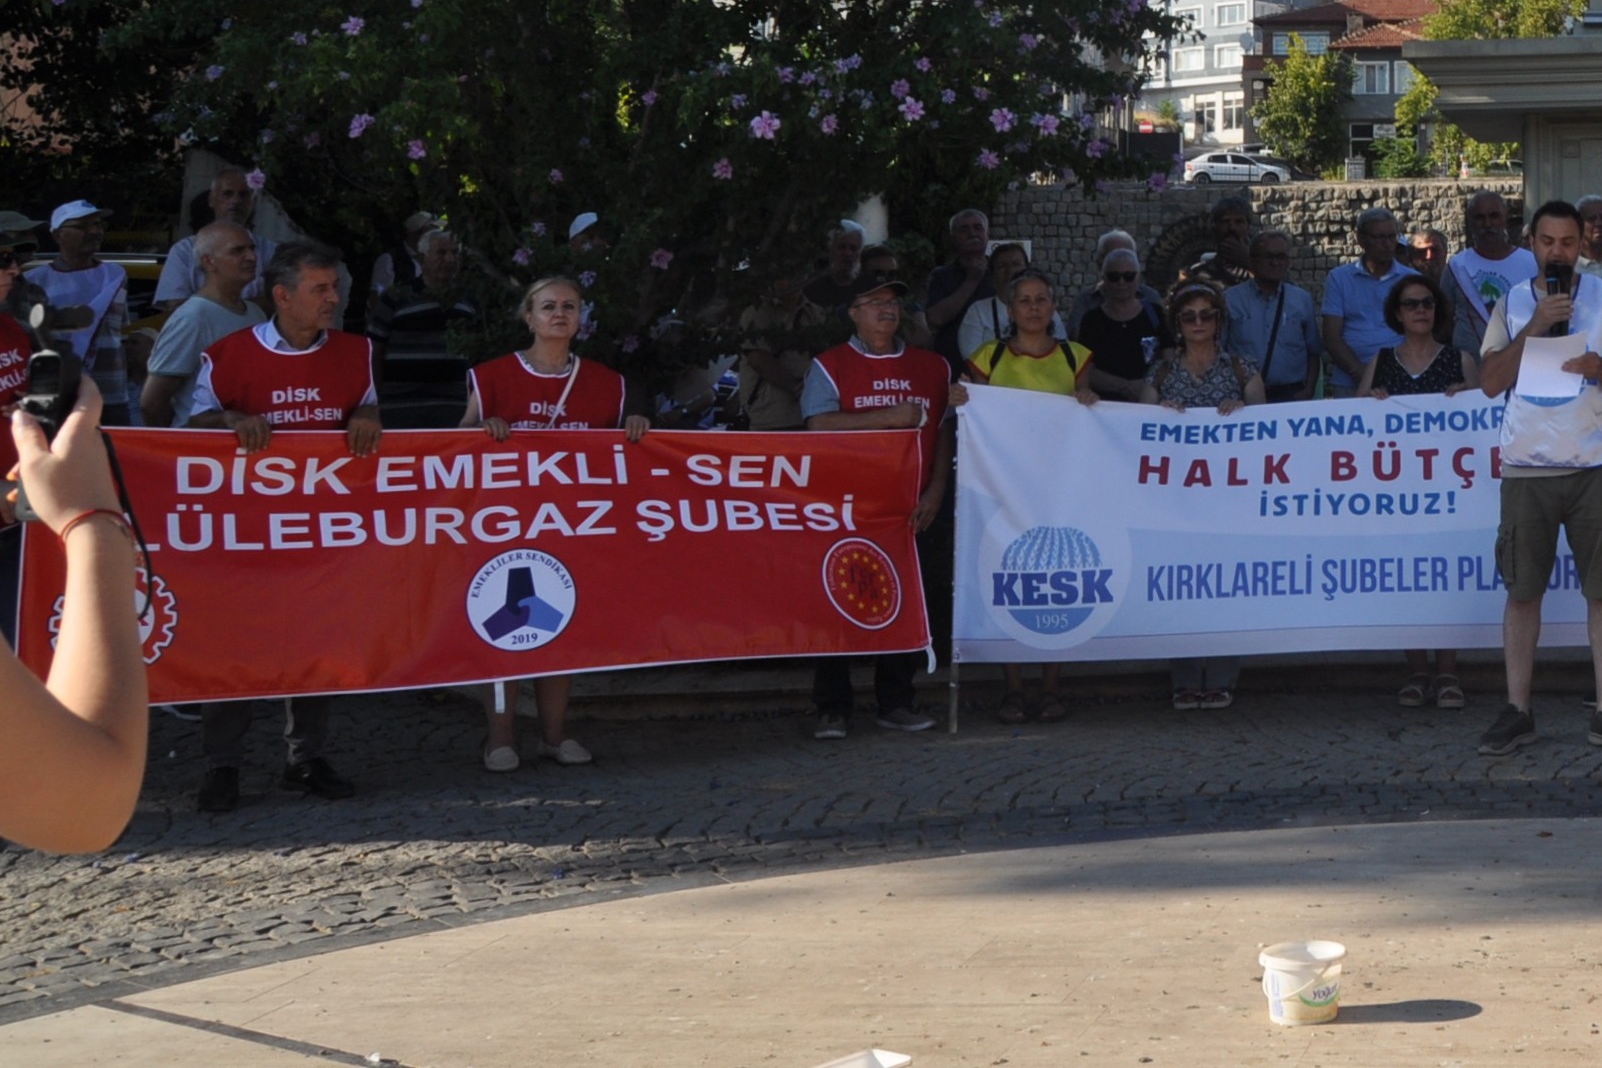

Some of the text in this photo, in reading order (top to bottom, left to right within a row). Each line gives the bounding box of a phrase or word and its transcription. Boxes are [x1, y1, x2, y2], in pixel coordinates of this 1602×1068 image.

[271, 386, 322, 405] DİSK
[872, 378, 912, 391] DİSK
[261, 405, 343, 425] MEKLİ-SEN
[1140, 404, 1504, 445] EMEKTEN YANA, DEMOKR
[176, 447, 354, 496] DİSK
[375, 444, 629, 493] EMEKLİ
[685, 454, 812, 488] SEN
[1138, 440, 1502, 489] HALK BÜTÇE
[635, 494, 857, 543] ŞUBESİ
[1259, 487, 1457, 517] İSTİYORUZ!
[470, 551, 574, 599] EMEKLİLER SENDİKASI
[992, 569, 1114, 606] KESK
[1146, 553, 1313, 602] KIRKLARELİ
[1321, 555, 1449, 601] ŞUBELER
[510, 632, 539, 645] 2019
[1035, 613, 1069, 629] 1995
